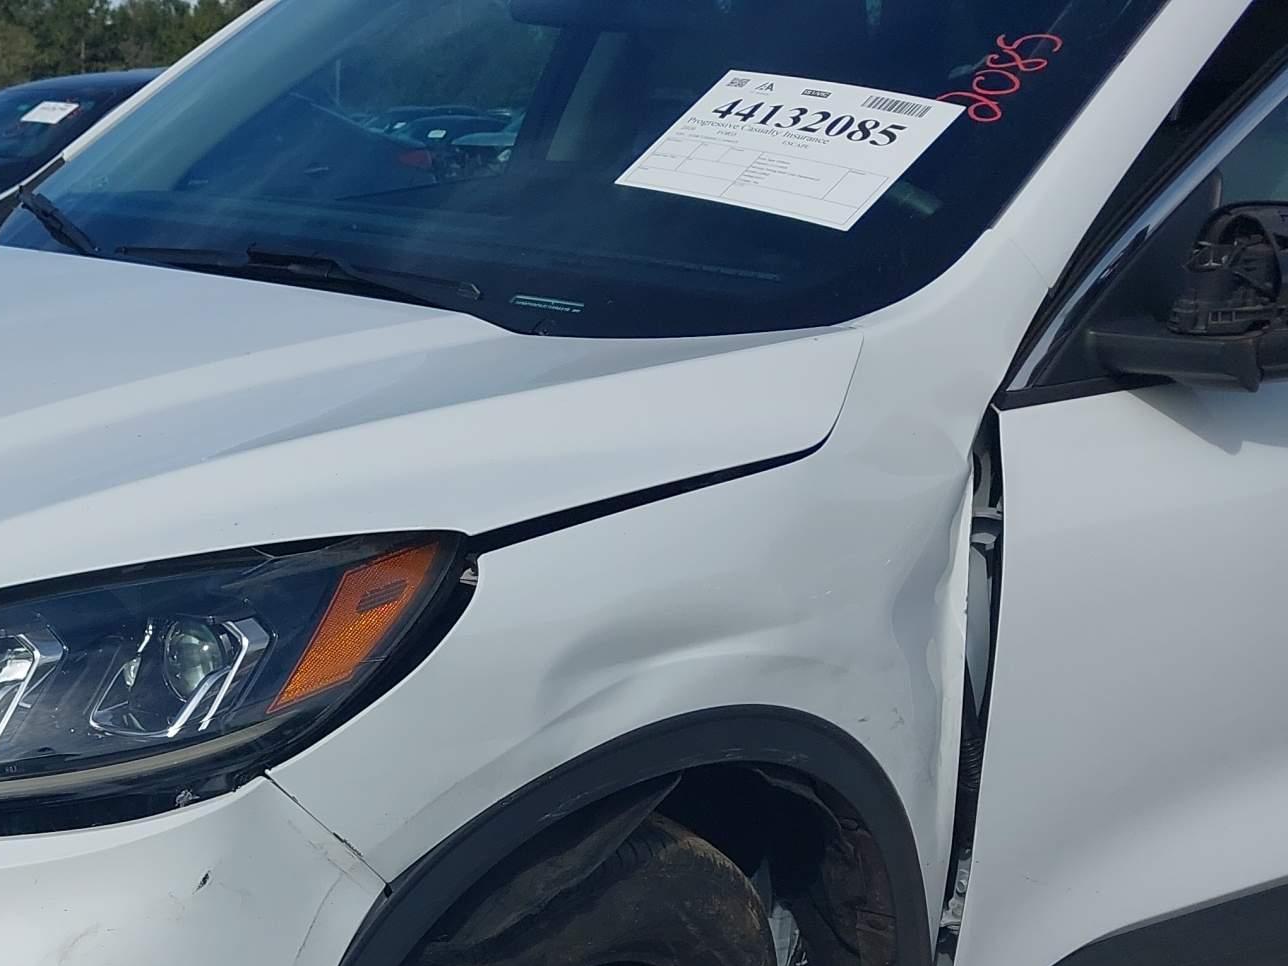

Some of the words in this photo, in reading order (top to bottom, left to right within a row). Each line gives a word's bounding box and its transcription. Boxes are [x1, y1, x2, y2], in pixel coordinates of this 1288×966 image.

[936, 34, 1062, 122] 2085
[687, 117, 740, 131] Progressive
[741, 123, 780, 138] Casualty
[782, 130, 830, 145] Insurance
[711, 98, 907, 147] 44132085
